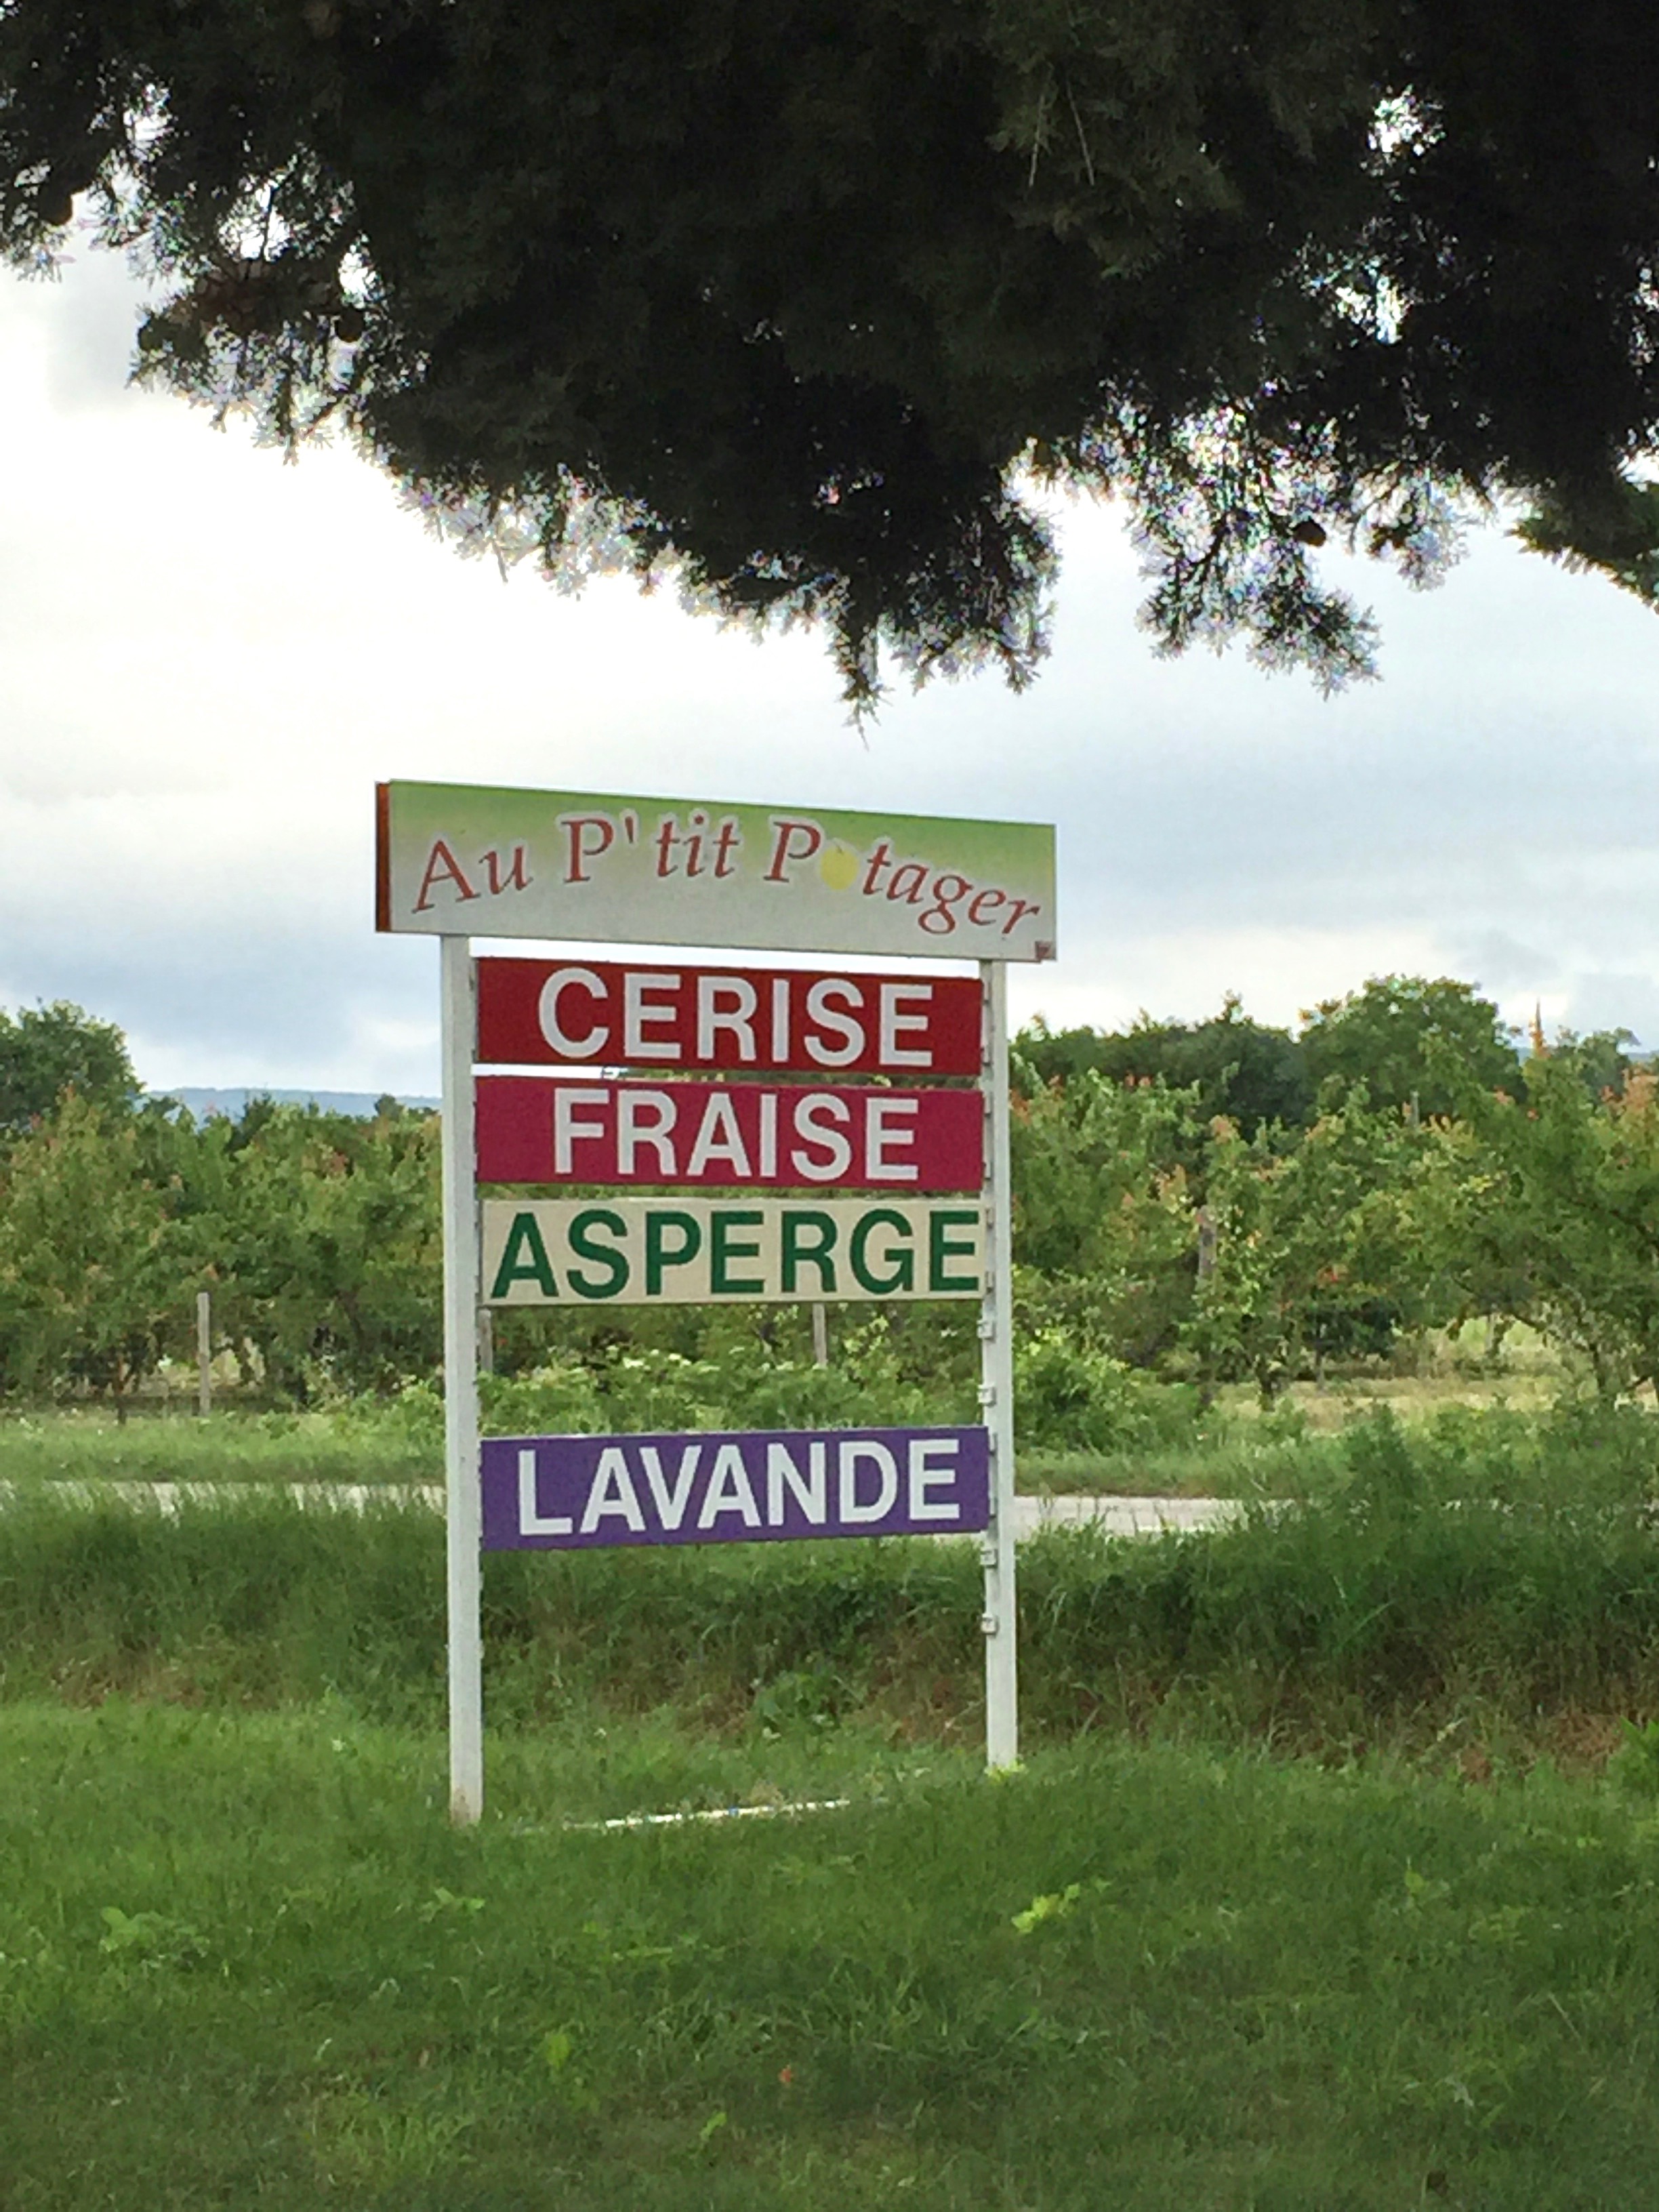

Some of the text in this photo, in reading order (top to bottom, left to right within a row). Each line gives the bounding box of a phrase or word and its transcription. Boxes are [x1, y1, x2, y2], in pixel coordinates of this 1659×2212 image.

[411, 839, 533, 914] Au
[561, 815, 739, 884] P'tit
[538, 967, 933, 1067] CERISE
[554, 1087, 919, 1181] FRAISE
[490, 1208, 980, 1300] ASPERGE
[517, 1439, 961, 1536] LAVANDE
